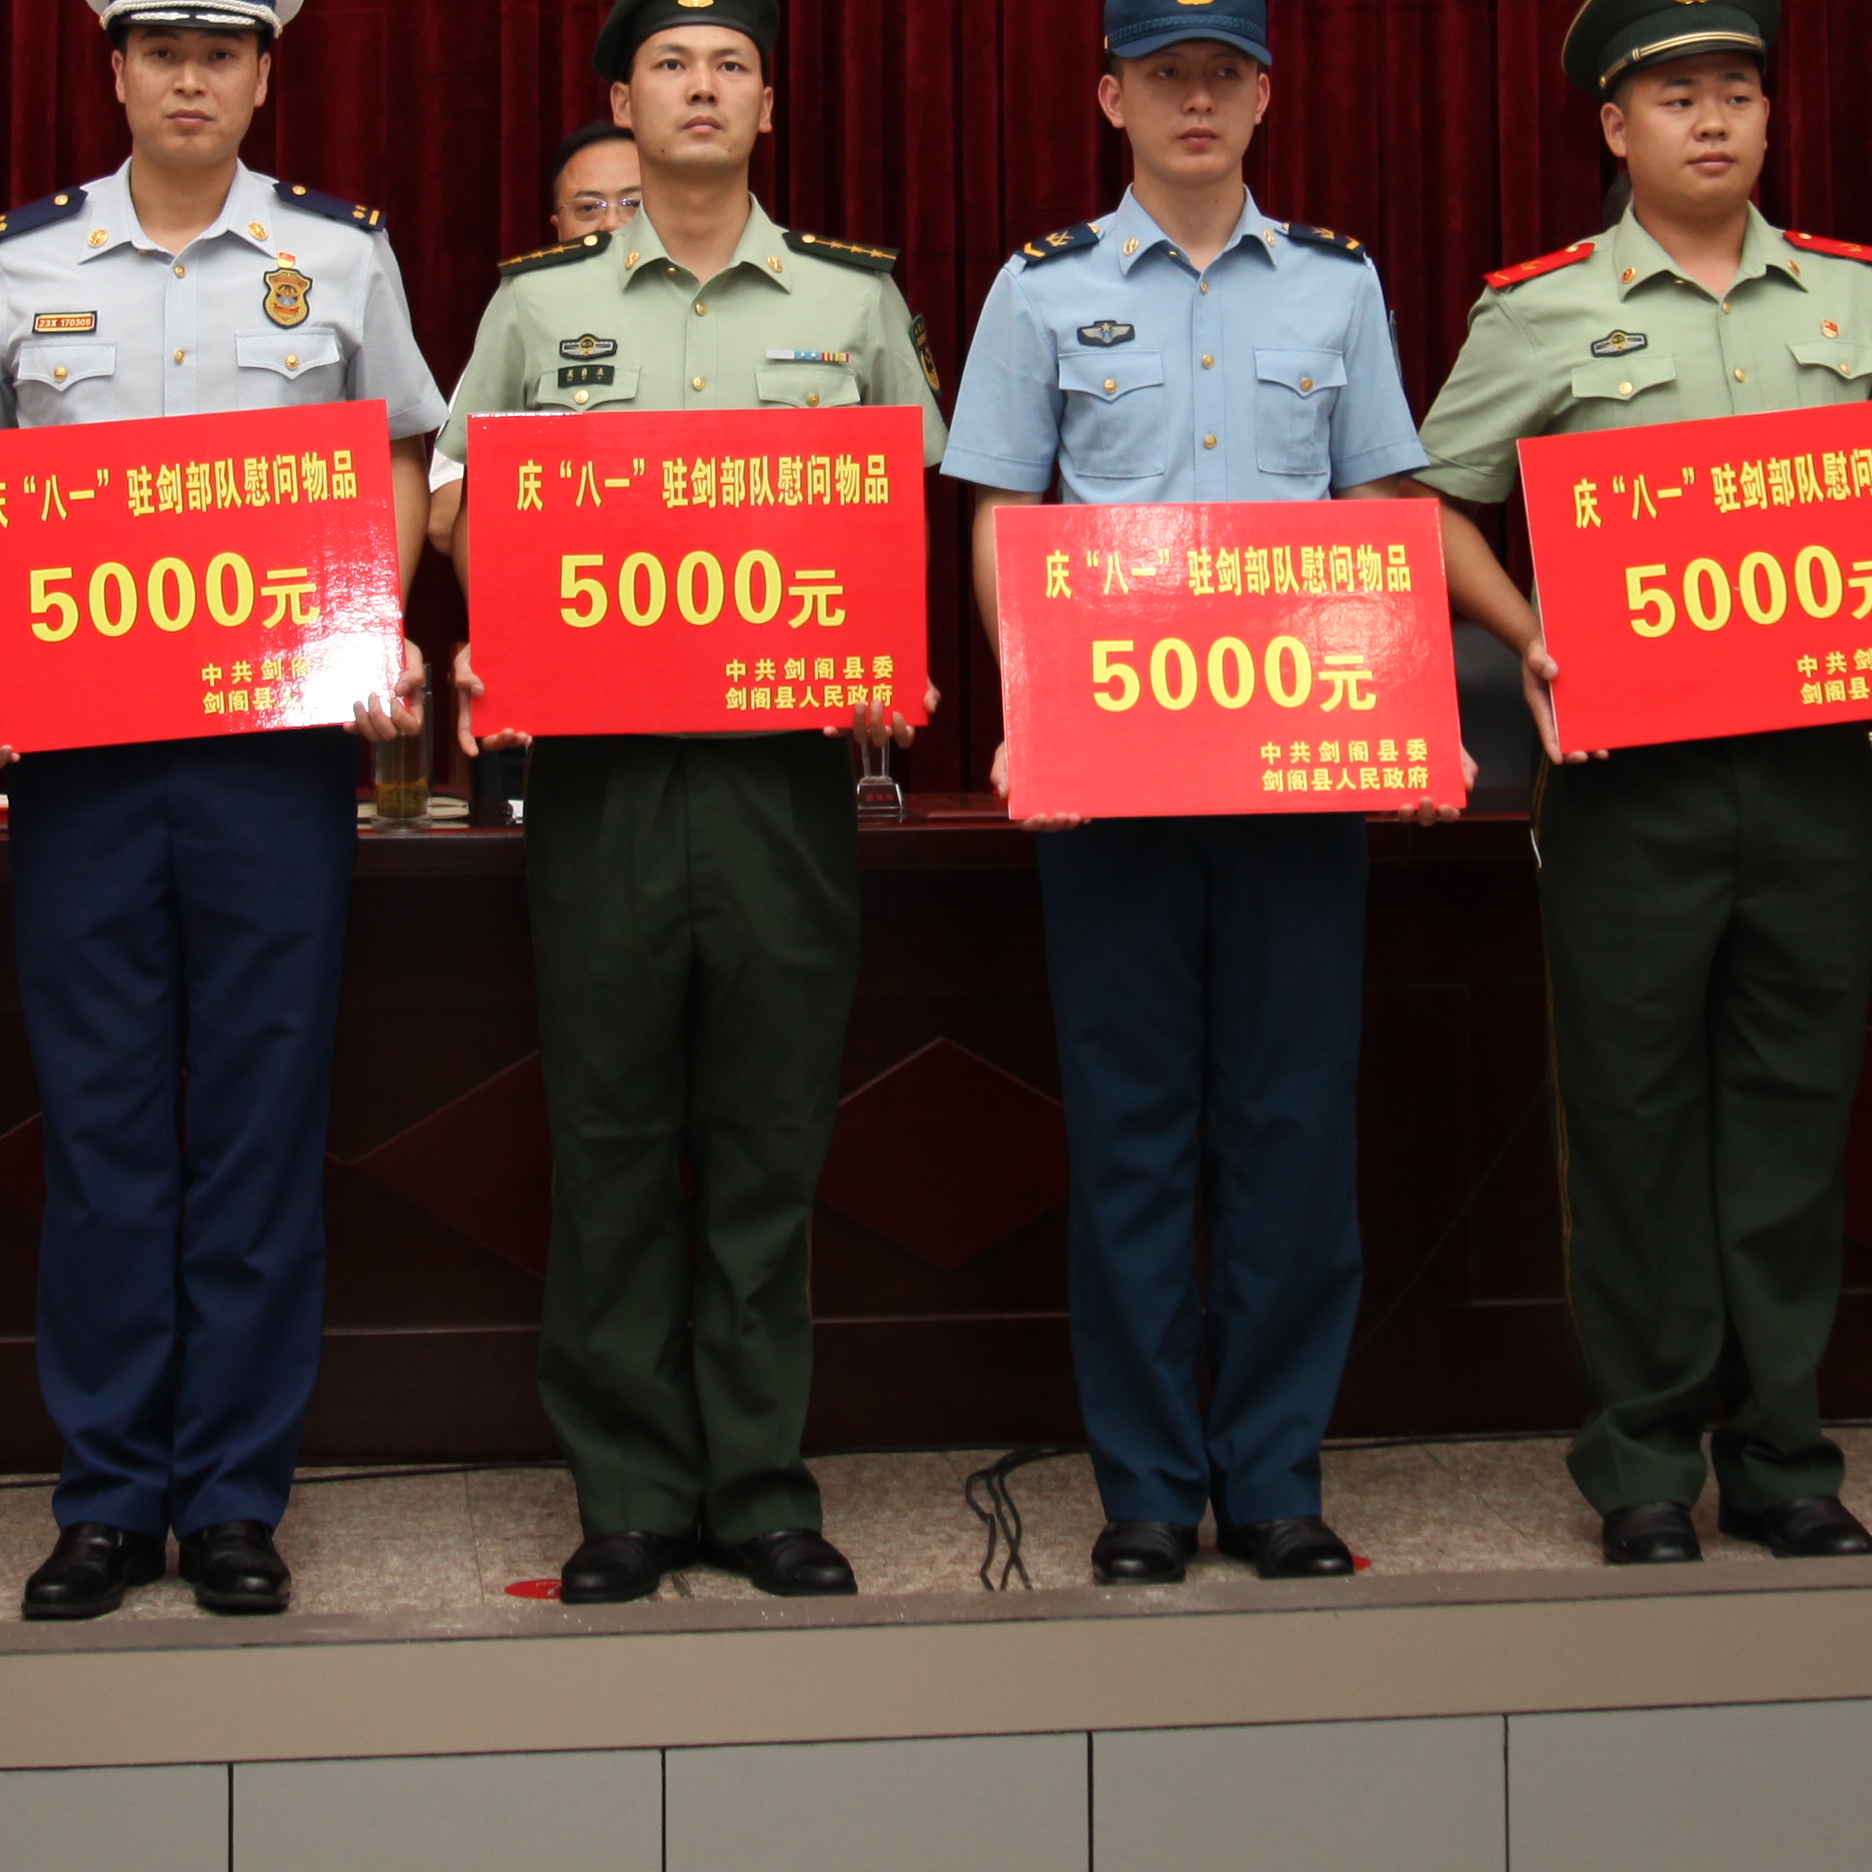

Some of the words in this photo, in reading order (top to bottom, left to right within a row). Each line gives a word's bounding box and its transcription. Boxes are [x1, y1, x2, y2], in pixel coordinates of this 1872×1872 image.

[31, 553, 319, 641] 5000元
[561, 550, 845, 628] 5000元
[727, 656, 892, 681] 中共剑阁县委
[1093, 635, 1376, 712] 5000元
[726, 684, 892, 709] 剑阁县人民政府
[1261, 739, 1427, 763] 中共剑阁县委
[1262, 766, 1428, 791] 剑阁县人民政府
